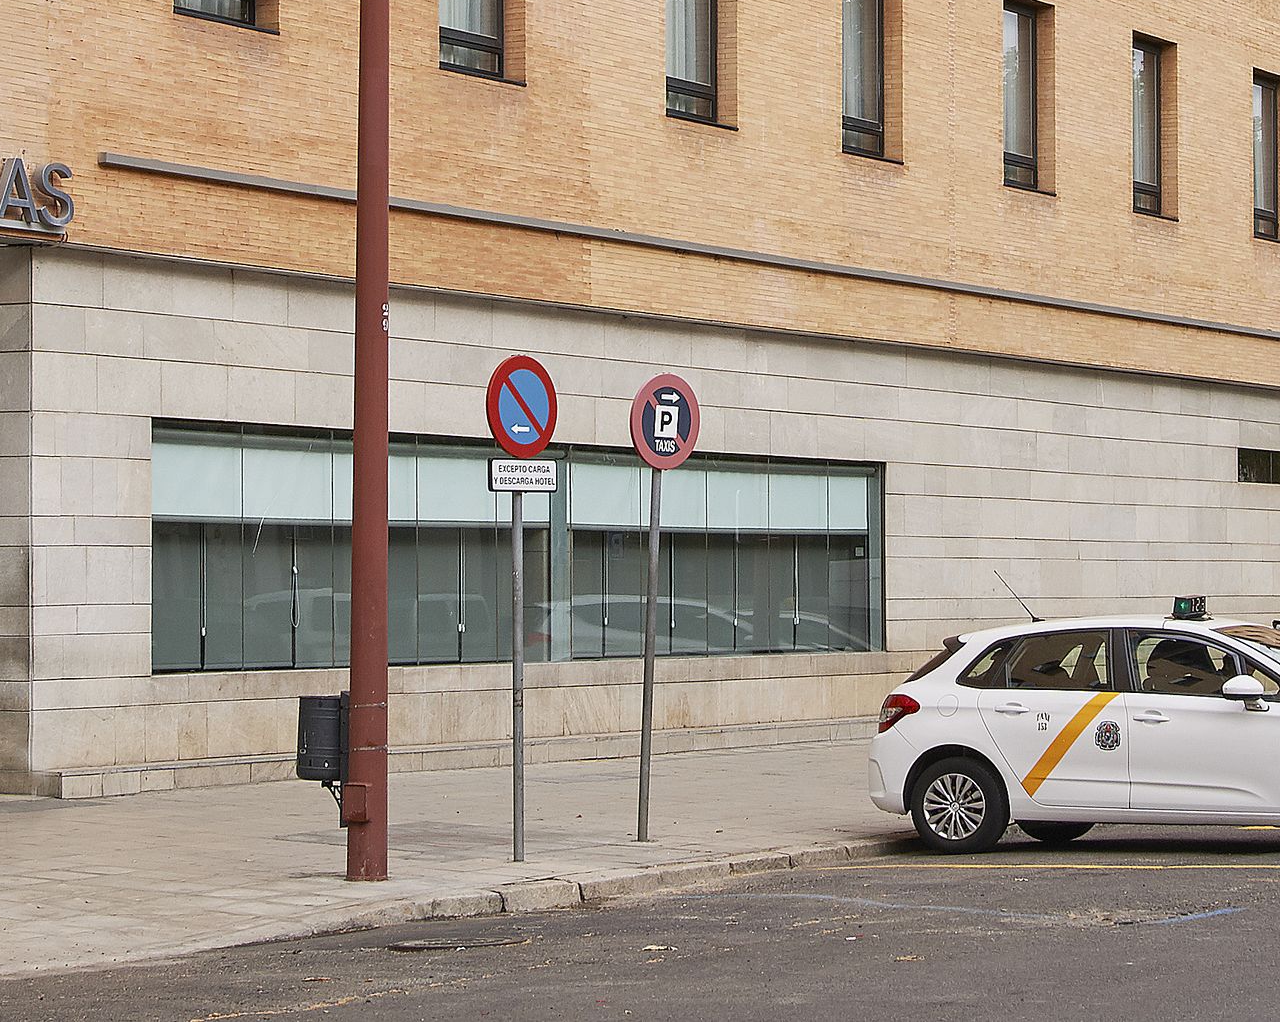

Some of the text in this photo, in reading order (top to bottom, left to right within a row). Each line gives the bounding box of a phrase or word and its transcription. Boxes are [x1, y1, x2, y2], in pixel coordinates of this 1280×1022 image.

[660, 410, 673, 432] P
[654, 439, 676, 453] TAXIS
[498, 464, 551, 474] EXCEPTO CARGA
[493, 476, 556, 486] Y DESCARGA HOTEL
